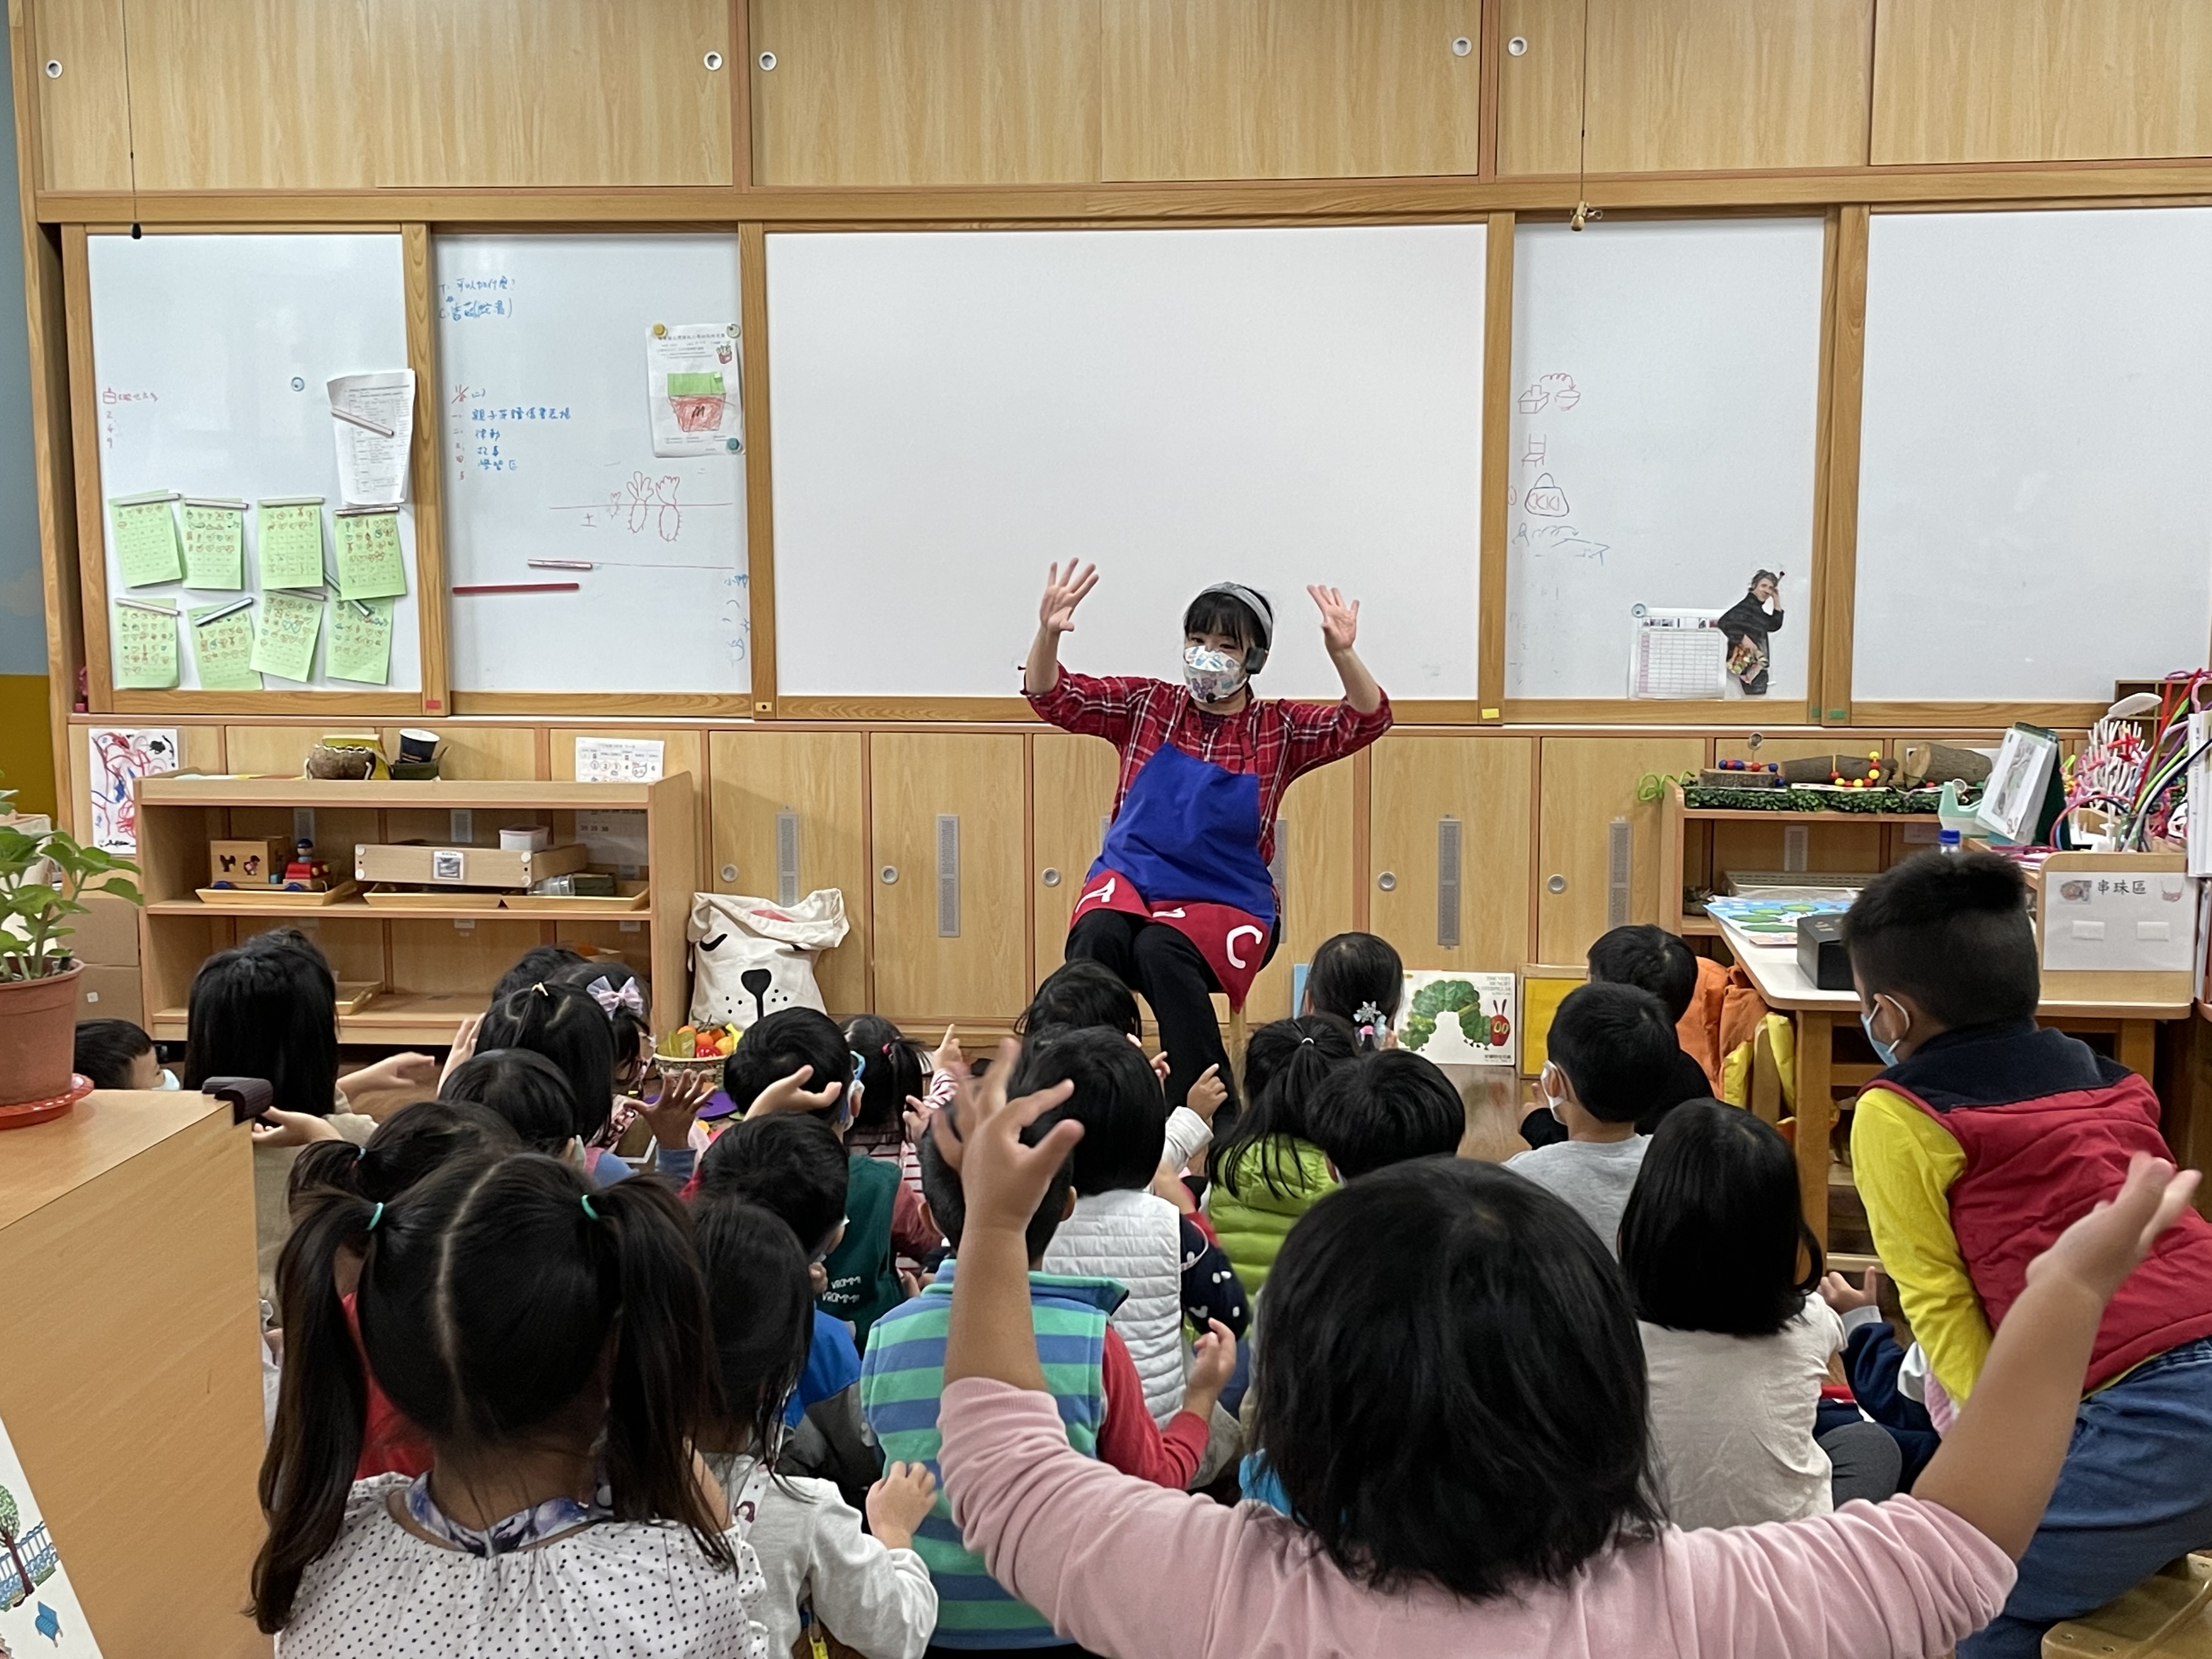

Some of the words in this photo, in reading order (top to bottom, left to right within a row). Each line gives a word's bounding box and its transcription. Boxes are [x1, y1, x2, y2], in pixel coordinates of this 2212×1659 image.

[2097, 879, 2147, 895] 串珠區
[1226, 925, 1263, 969] C
